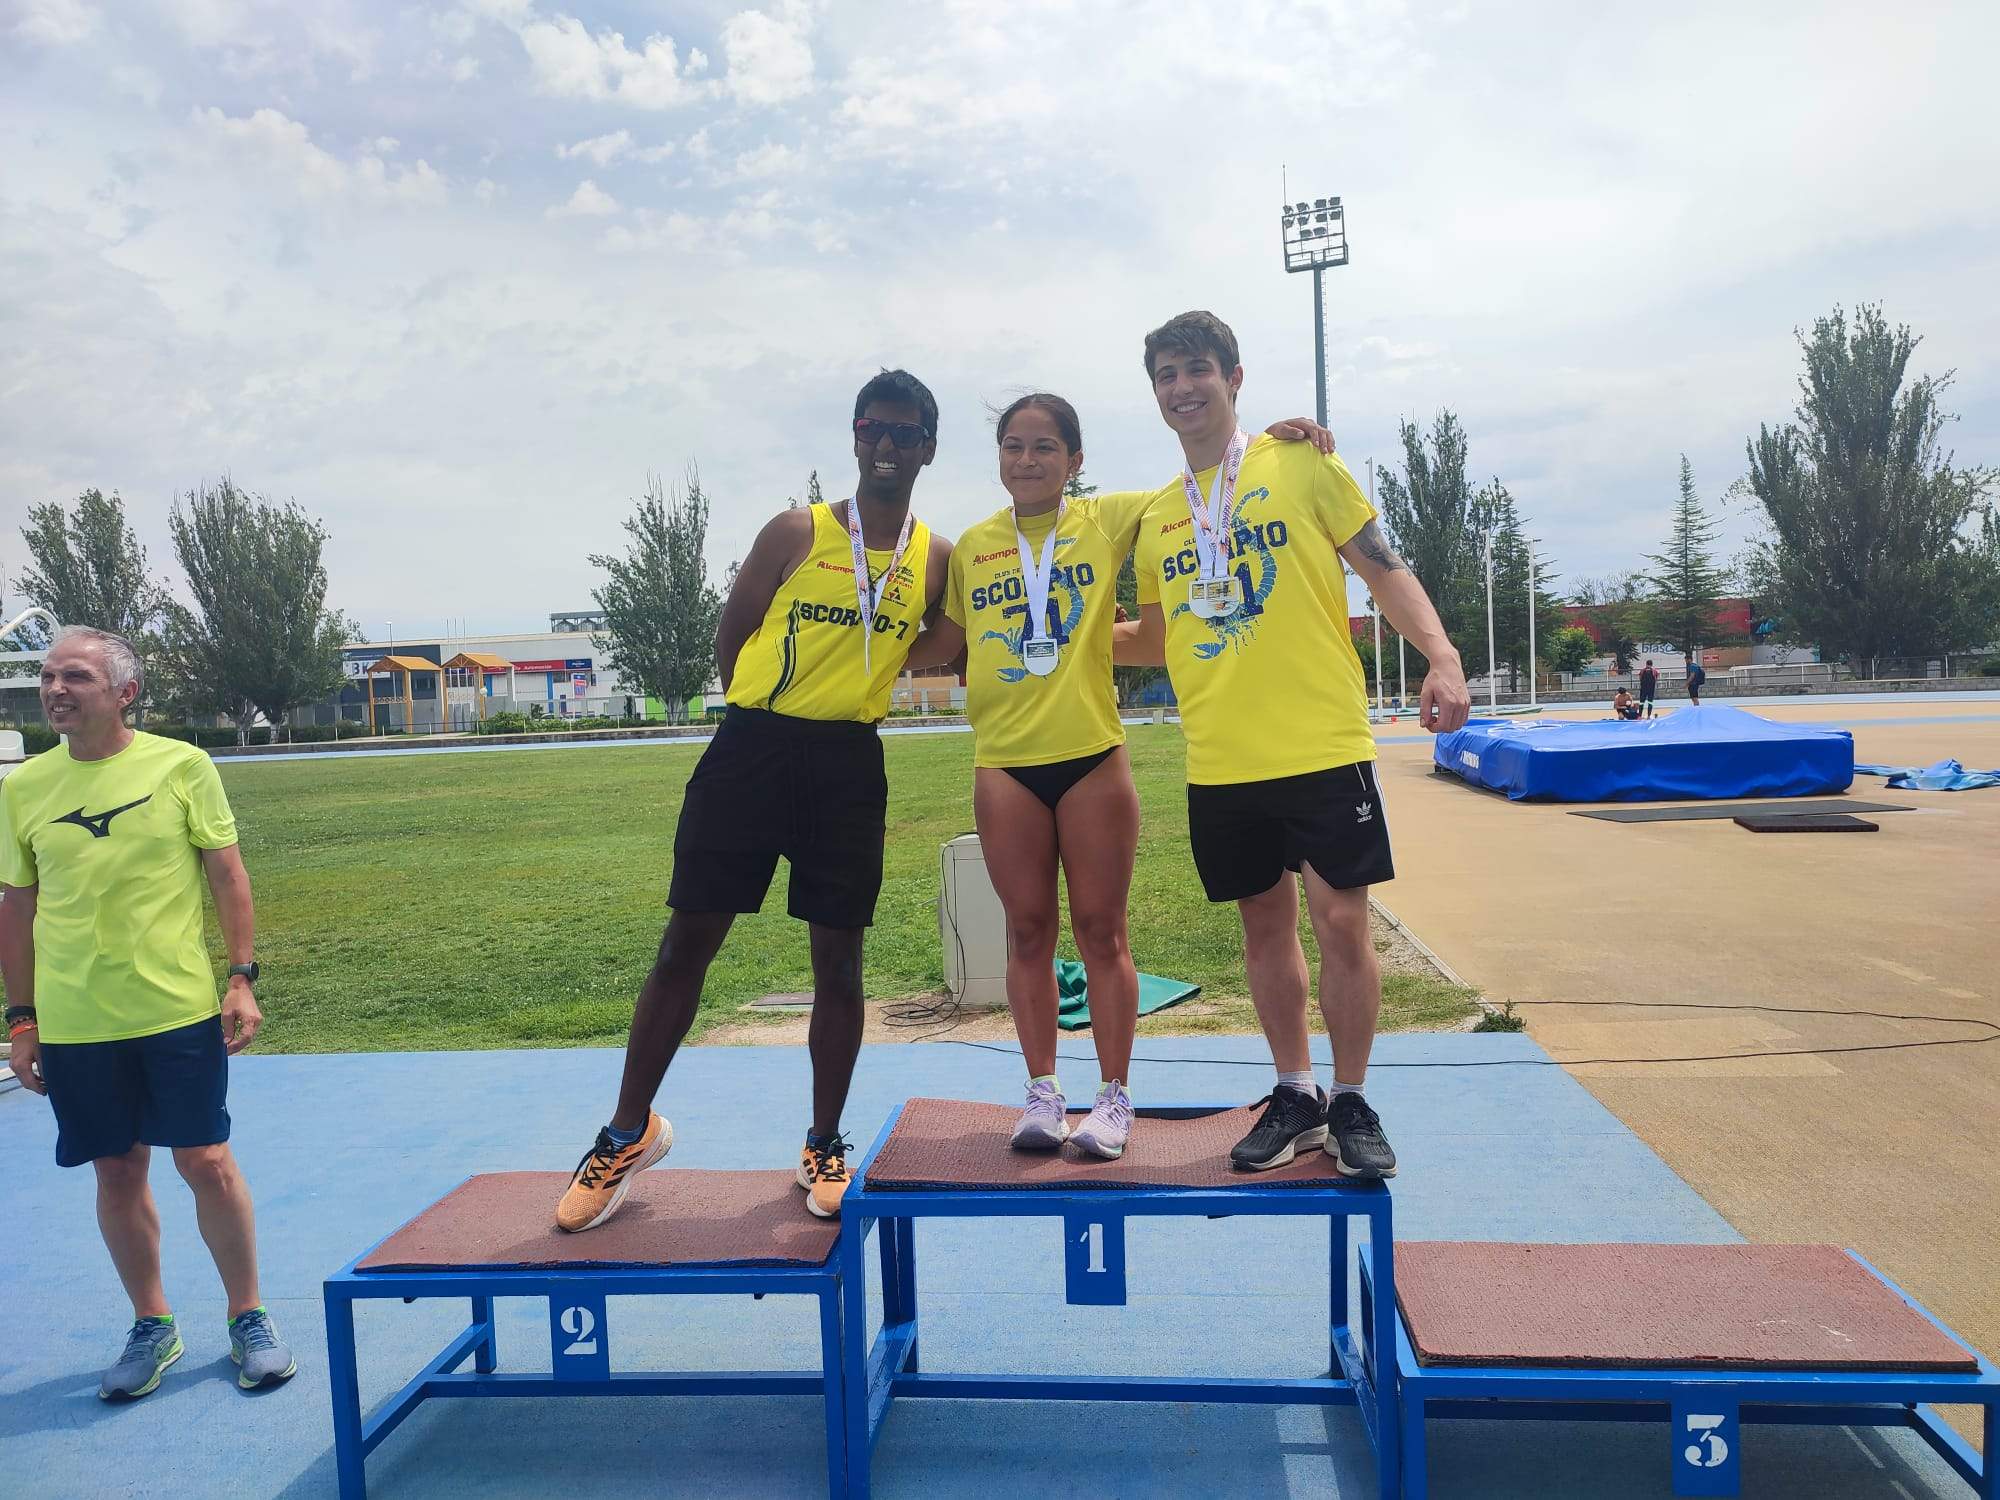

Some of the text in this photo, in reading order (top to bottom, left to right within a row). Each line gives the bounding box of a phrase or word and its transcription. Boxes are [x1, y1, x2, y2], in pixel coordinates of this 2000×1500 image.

[816, 560, 856, 575] Alcampo
[973, 547, 1019, 566] Alcampo
[1163, 520, 1288, 583] SCPIO
[971, 562, 1095, 611] SCOPIO
[800, 602, 910, 641] SCORO-7
[1080, 1223, 1107, 1273] 1
[560, 1306, 597, 1355] 2
[1684, 1414, 1729, 1468] 3
